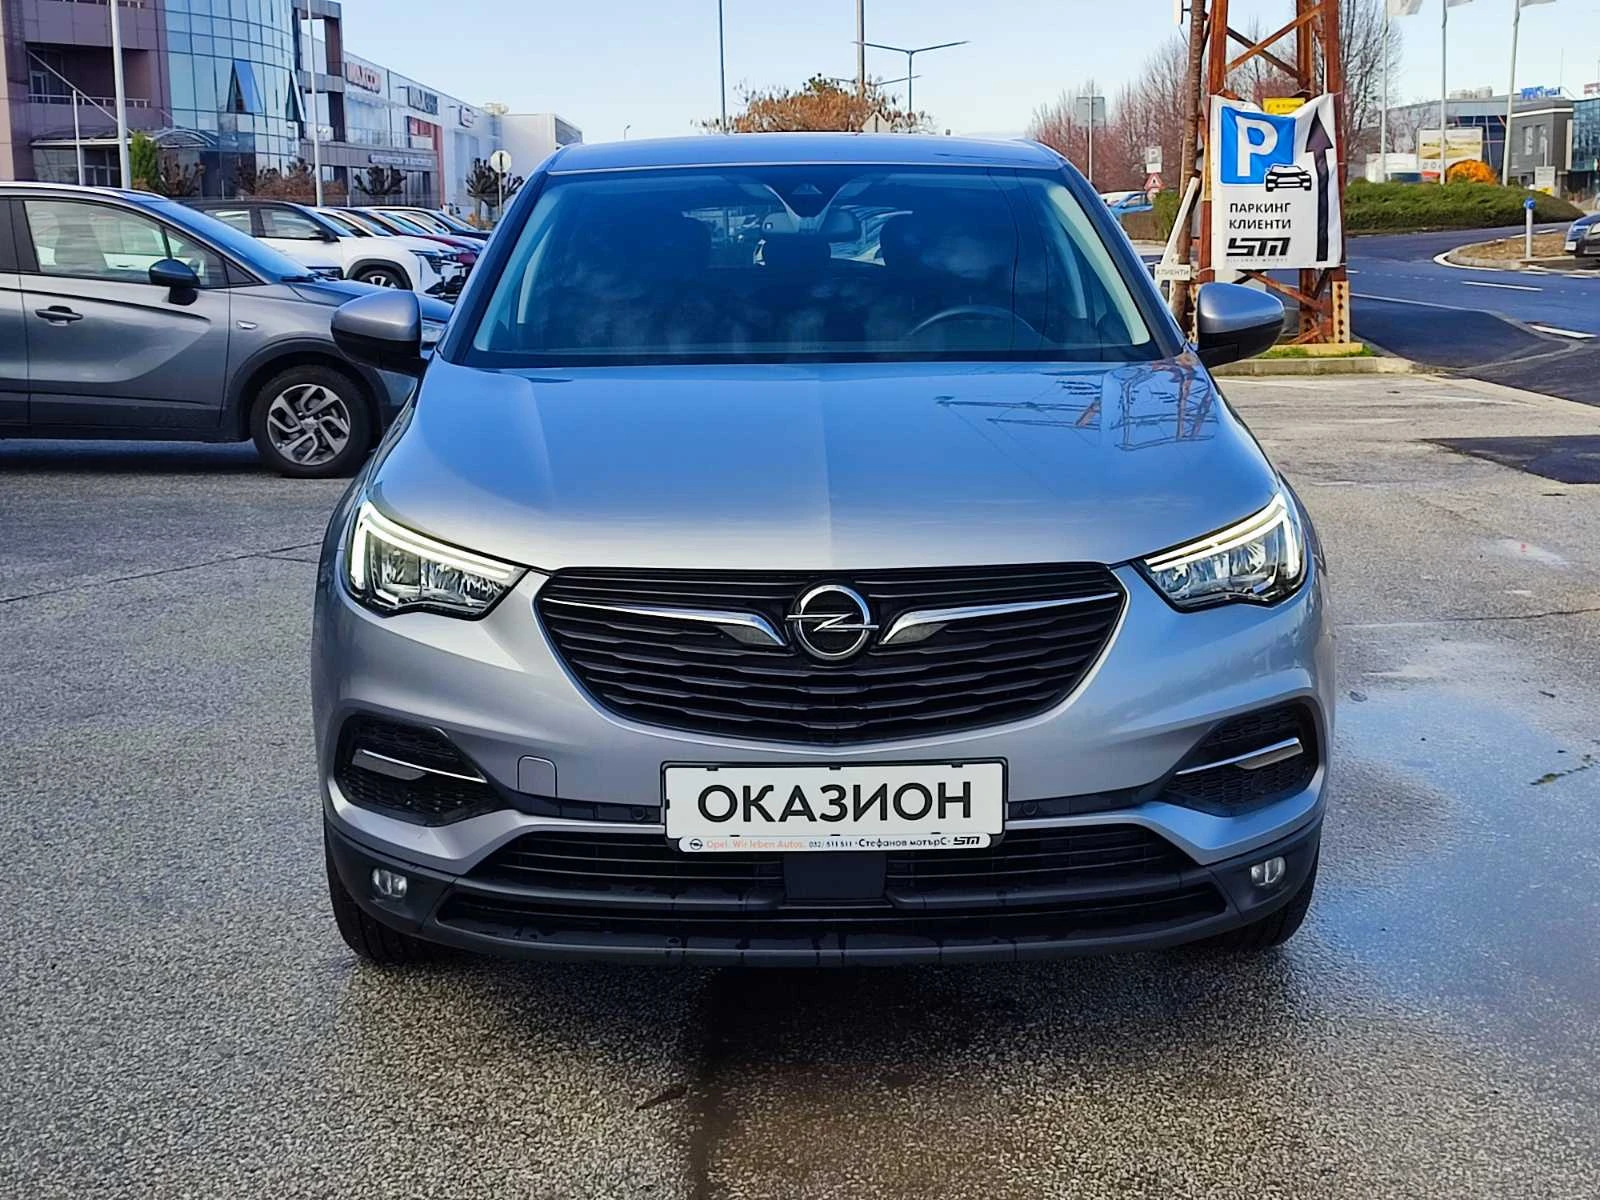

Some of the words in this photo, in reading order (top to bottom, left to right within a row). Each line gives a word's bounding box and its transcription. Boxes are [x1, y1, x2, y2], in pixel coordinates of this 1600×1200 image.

[1235, 115, 1278, 177] P
[1229, 202, 1291, 214] ПАРКИНГ
[1229, 219, 1291, 230] КЛИЕНТИ
[697, 781, 971, 823] ОКАЗИОН
[858, 837, 907, 848] Стефанов
